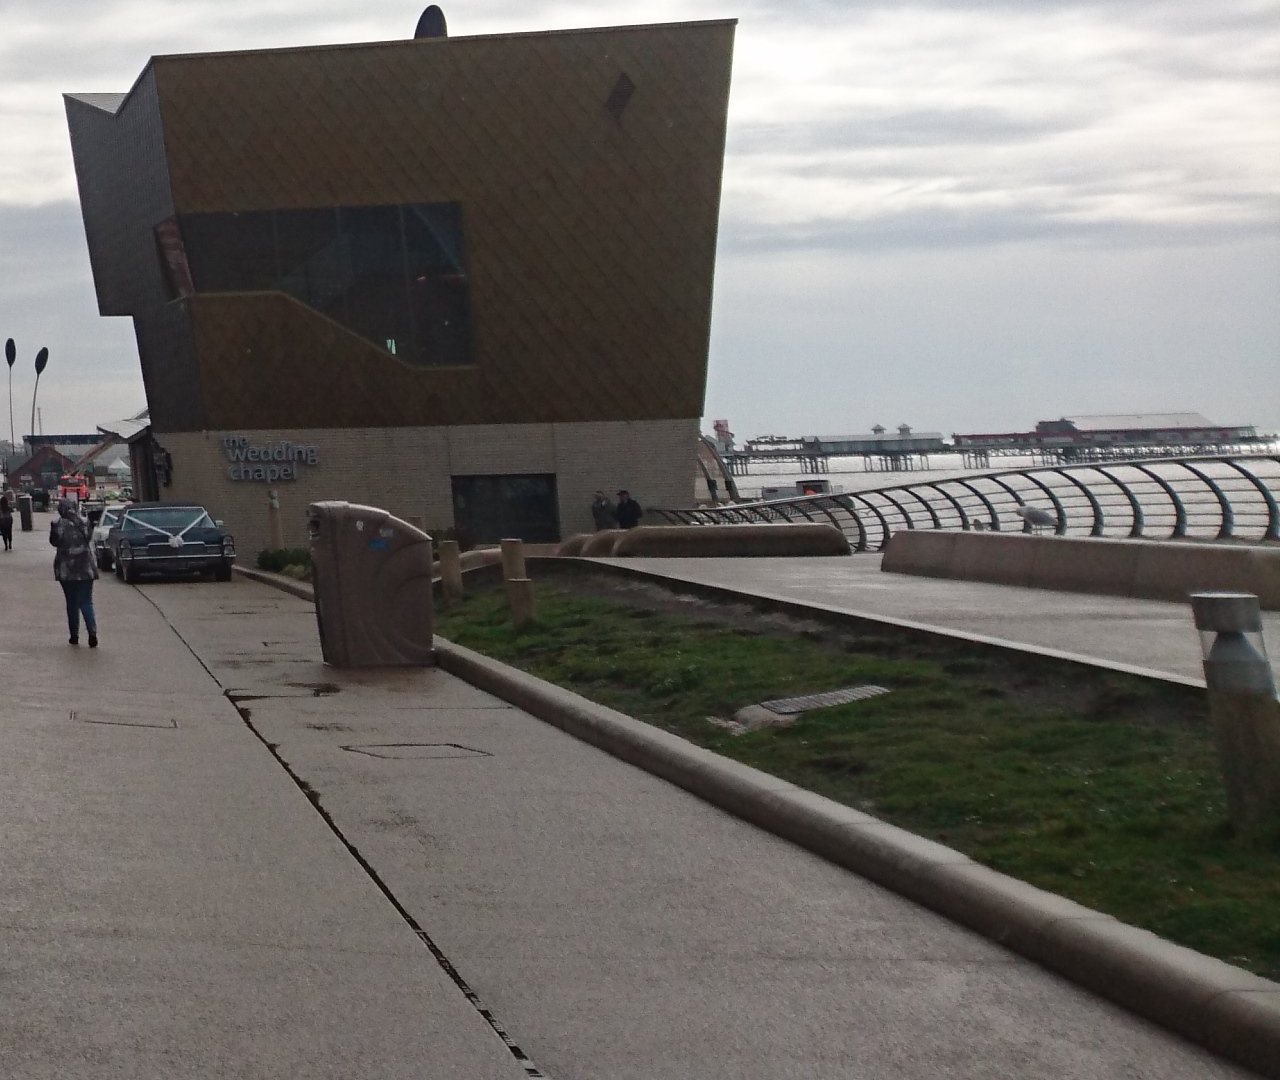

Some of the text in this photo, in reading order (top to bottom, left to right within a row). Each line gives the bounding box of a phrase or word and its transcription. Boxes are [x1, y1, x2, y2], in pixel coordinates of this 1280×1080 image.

[223, 434, 248, 448] the
[227, 440, 320, 465] wedding
[228, 462, 298, 483] chapel
